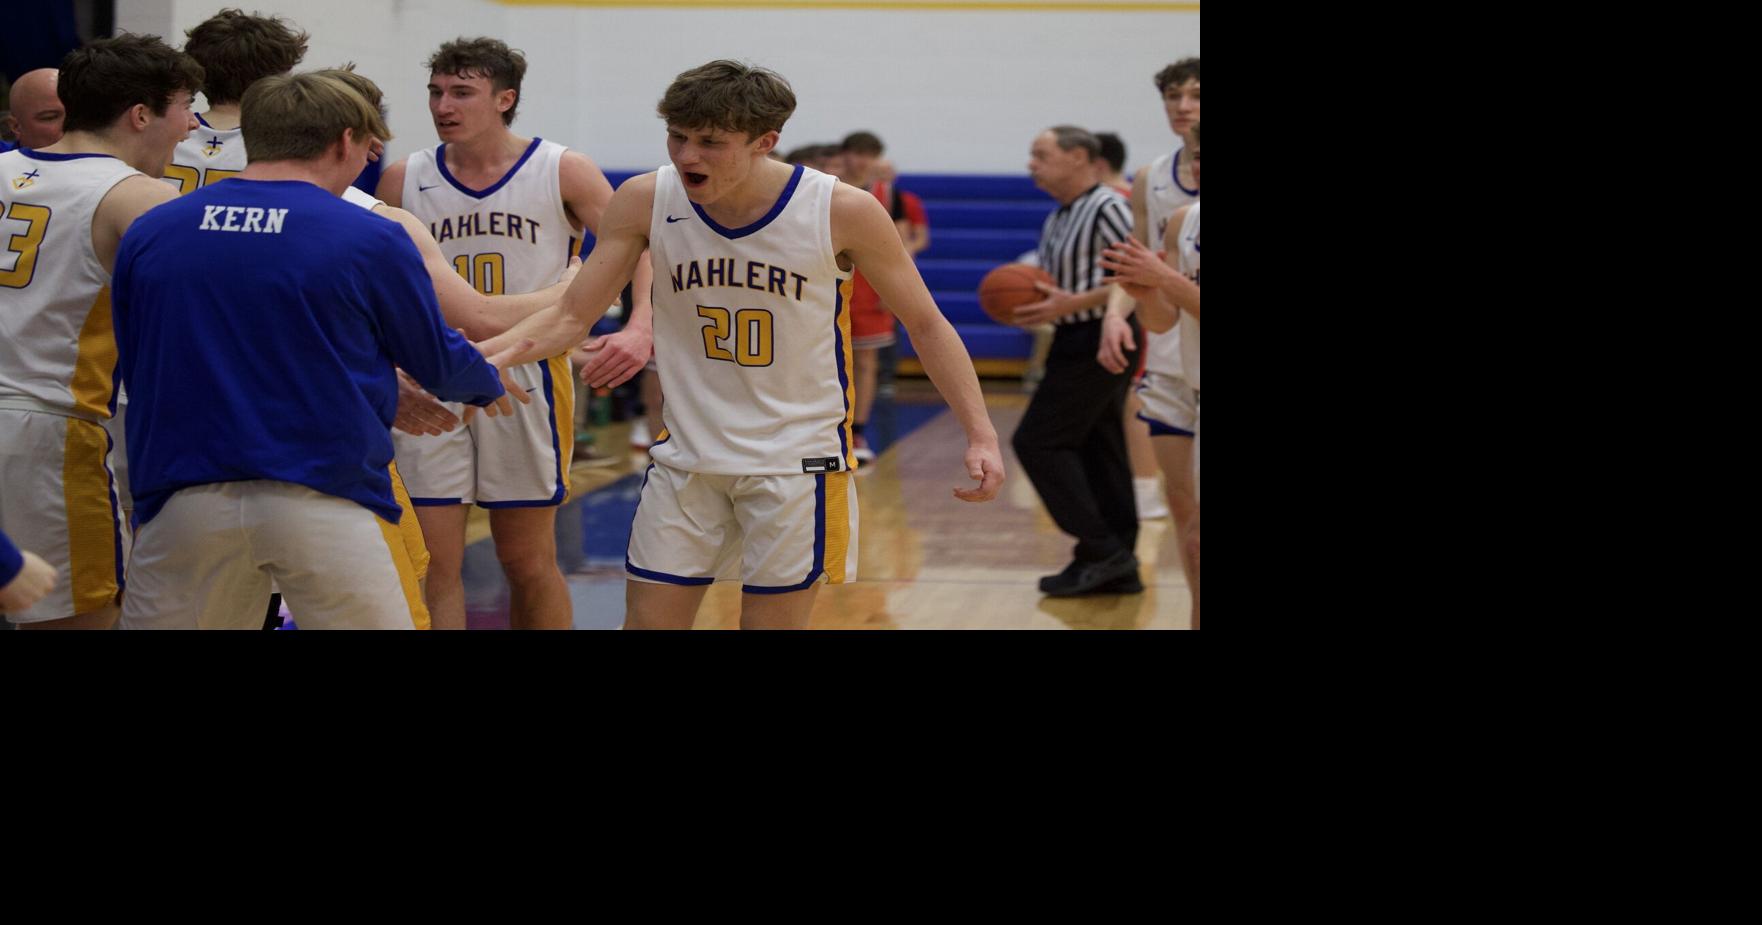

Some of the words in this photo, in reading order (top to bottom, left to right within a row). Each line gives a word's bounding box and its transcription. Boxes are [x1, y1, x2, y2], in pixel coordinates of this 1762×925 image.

[199, 204, 289, 234] KERN
[431, 211, 541, 245] AHLERT
[0, 201, 52, 289] 3
[696, 304, 774, 367] 20
